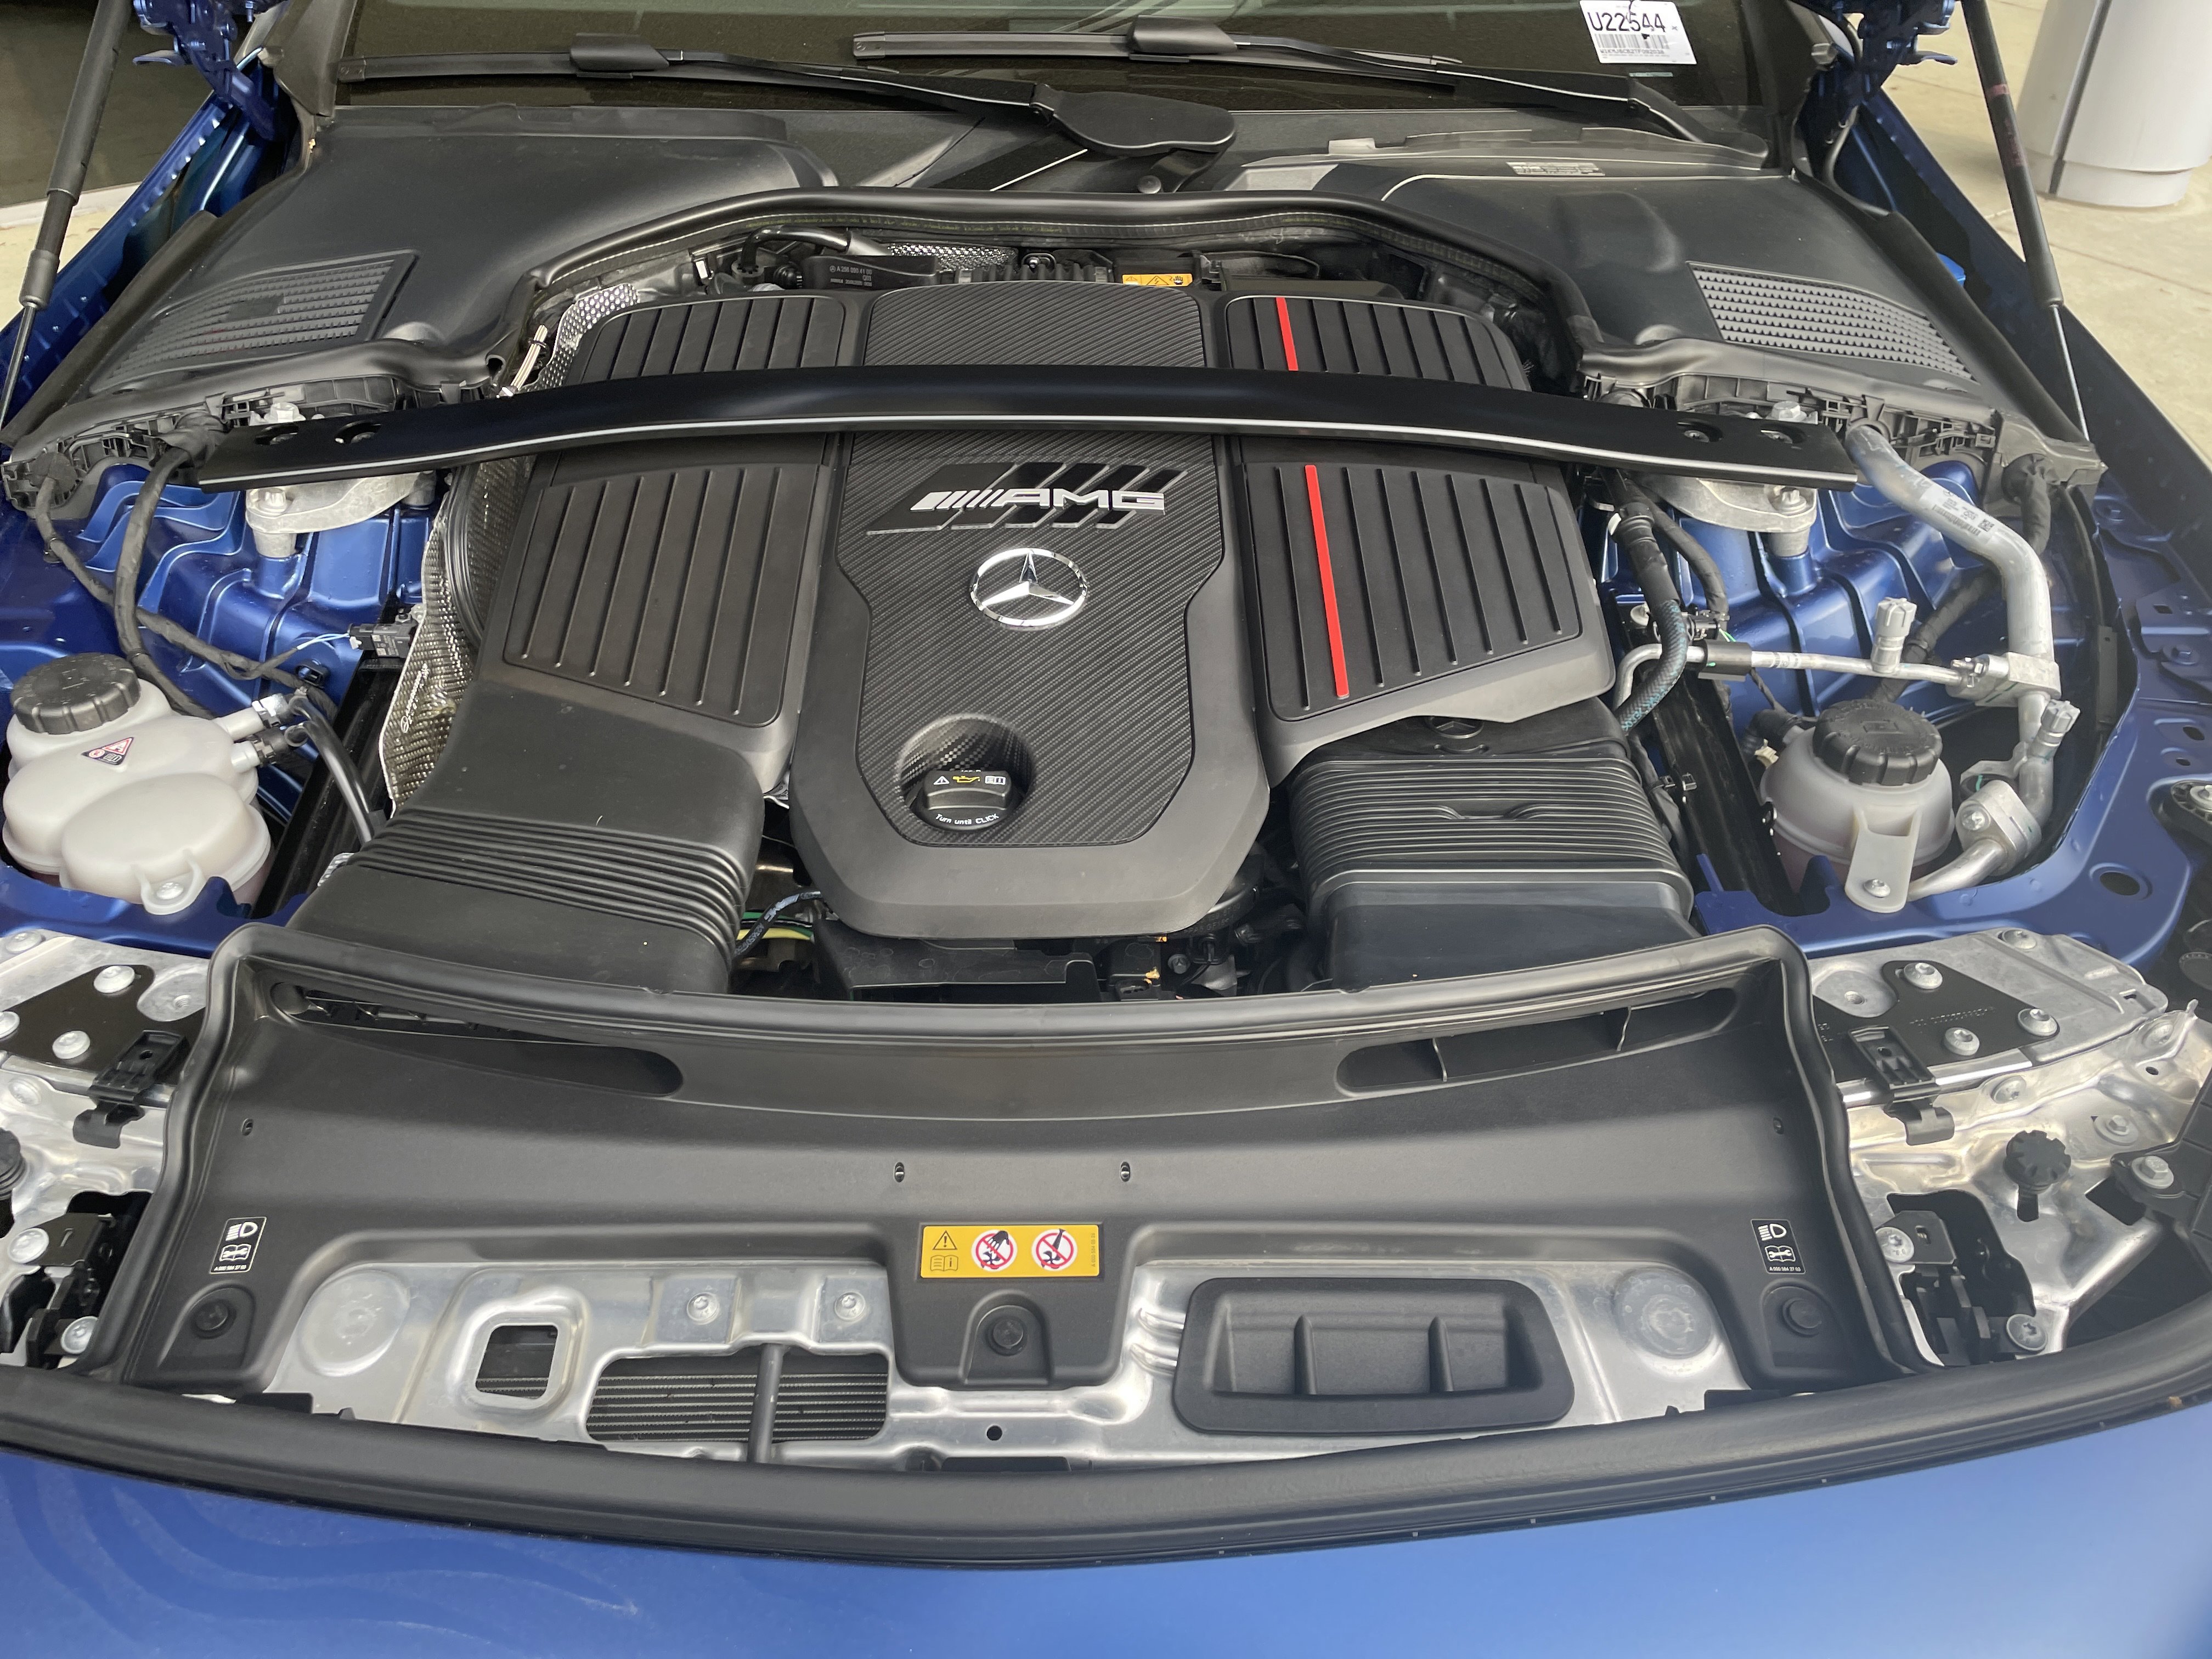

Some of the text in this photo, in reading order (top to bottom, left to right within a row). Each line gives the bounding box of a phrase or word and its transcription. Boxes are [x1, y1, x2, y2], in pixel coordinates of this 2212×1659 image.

[1587, 12, 1666, 32] U22544
[991, 488, 1165, 515] AMG
[935, 813, 952, 823] Turn
[975, 813, 999, 824] CLICK
